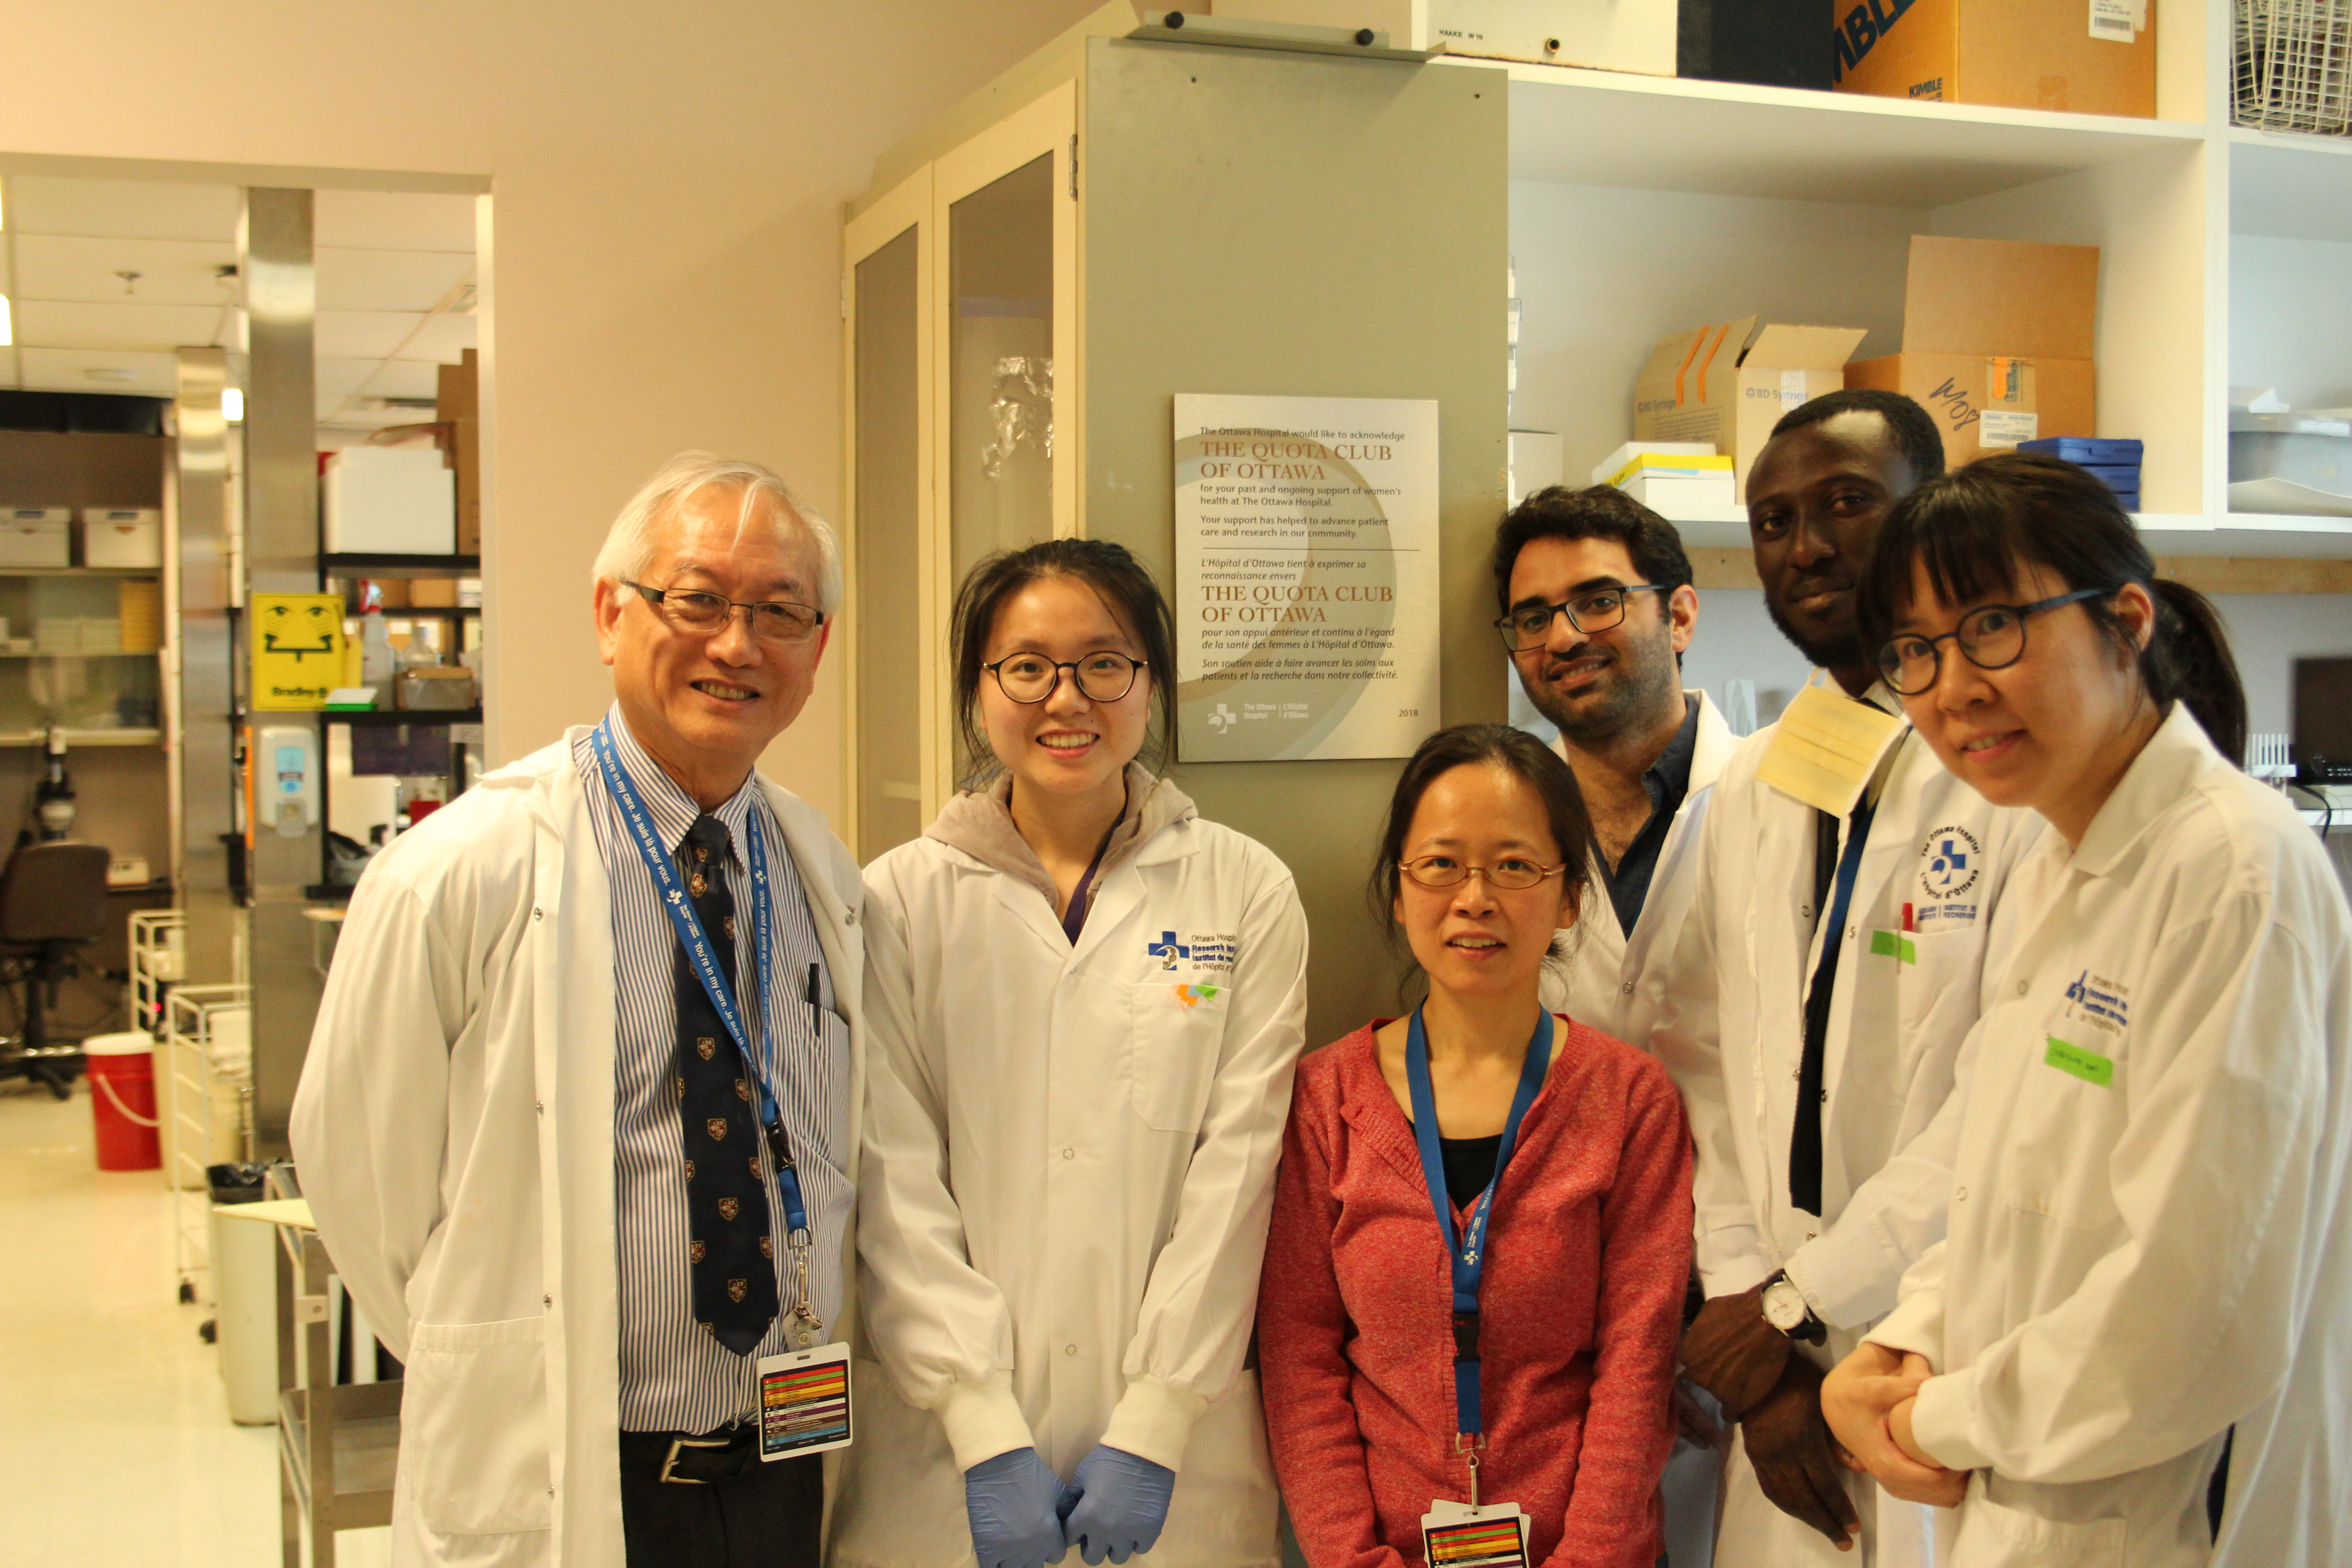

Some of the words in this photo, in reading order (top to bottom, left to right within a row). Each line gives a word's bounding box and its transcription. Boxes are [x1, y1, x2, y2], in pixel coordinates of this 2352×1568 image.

[1439, 29, 1462, 38] HAAKE
[1833, 0, 1916, 83] MBL
[1909, 78, 1942, 98] KIMBLE
[1757, 389, 1769, 398] BD
[1200, 427, 1216, 436] The
[1219, 428, 1250, 436] Ottawa
[1254, 429, 1289, 438] Hospital
[1292, 430, 1318, 438] would
[1321, 430, 1336, 439] like
[1350, 431, 1405, 442] acknowledge
[1200, 442, 1245, 457] THE
[1252, 442, 1327, 462] QUOTA
[1335, 445, 1392, 461] CLUB
[1200, 463, 1231, 479] OF
[1237, 464, 1326, 480] OTTAWA
[1200, 484, 1213, 493] for
[1215, 486, 1235, 495] your
[1238, 485, 1256, 495] past
[1259, 485, 1275, 494] and
[1278, 485, 1314, 496] ongoing
[1317, 487, 1349, 496] support
[1352, 486, 1361, 495] of
[1364, 487, 1401, 495] women's
[1200, 496, 1228, 505] health
[1242, 497, 1259, 505] The
[1261, 498, 1293, 506] Ottawa
[1296, 498, 1333, 508] Hospital.
[1200, 515, 1220, 524] Your
[1224, 516, 1257, 526] support
[1260, 516, 1274, 525] has
[1277, 516, 1307, 527] helped
[1321, 517, 1356, 526] advance
[1358, 518, 1388, 527] patient
[1222, 528, 1238, 537] and
[1241, 528, 1277, 537] research
[1280, 529, 1288, 537] in
[1308, 529, 1357, 539] community.
[1201, 559, 1240, 569] L'Hôpital
[1243, 559, 1284, 568] d'Ottawa
[1288, 560, 1307, 568] tient
[1309, 560, 1315, 569] à
[1317, 560, 1355, 570] exprimer
[1201, 572, 1267, 581] reconnaissance
[1201, 586, 1247, 602] THE
[1253, 586, 1329, 605] QUOTA
[1335, 586, 1393, 602] CLUB
[1201, 607, 1232, 622] OF
[1239, 607, 1327, 622] OTTAWA
[1201, 629, 1223, 638] pour
[1242, 628, 1268, 638] appui
[1270, 628, 1309, 637] antérieur
[1312, 629, 1319, 637] et
[1322, 628, 1354, 637] continu
[1357, 627, 1362, 637] à
[1365, 627, 1395, 638] l'égard
[1202, 641, 1212, 649] de
[1215, 641, 1223, 649] la
[1226, 640, 1250, 649] santé
[1252, 641, 1266, 650] des
[1269, 641, 1300, 650] femmes
[1303, 640, 1308, 649] à
[1312, 640, 1349, 651] L'Hôpital
[1352, 640, 1395, 649] d'Ottawa.
[1202, 660, 1218, 668] Son
[1221, 659, 1252, 668] soutien
[1255, 659, 1273, 667] aide
[1276, 659, 1281, 667] à
[1284, 658, 1303, 668] faire
[1342, 658, 1352, 667] les
[1356, 659, 1376, 667] soins
[1202, 671, 1237, 682] patients
[1240, 672, 1249, 680] et
[1251, 671, 1259, 680] la
[1262, 671, 1302, 680] recherche
[1304, 671, 1325, 680] dans
[1328, 671, 1349, 680] notre
[1352, 671, 1398, 680] collectivité.
[1398, 710, 1418, 718] 2018
[603, 749, 617, 773] You're
[612, 772, 621, 781] in
[617, 780, 627, 794] my
[622, 793, 636, 813] care.
[632, 813, 642, 823] Je
[637, 822, 650, 839] suis
[645, 837, 655, 848] là
[647, 845, 663, 864] pour
[657, 864, 671, 887] vous.
[1192, 943, 1224, 952] Research
[694, 941, 710, 967] You're
[705, 966, 714, 976] in
[709, 975, 720, 989] my
[715, 989, 727, 1009] care.
[725, 1010, 734, 1020] Je
[730, 1020, 740, 1037] suis
